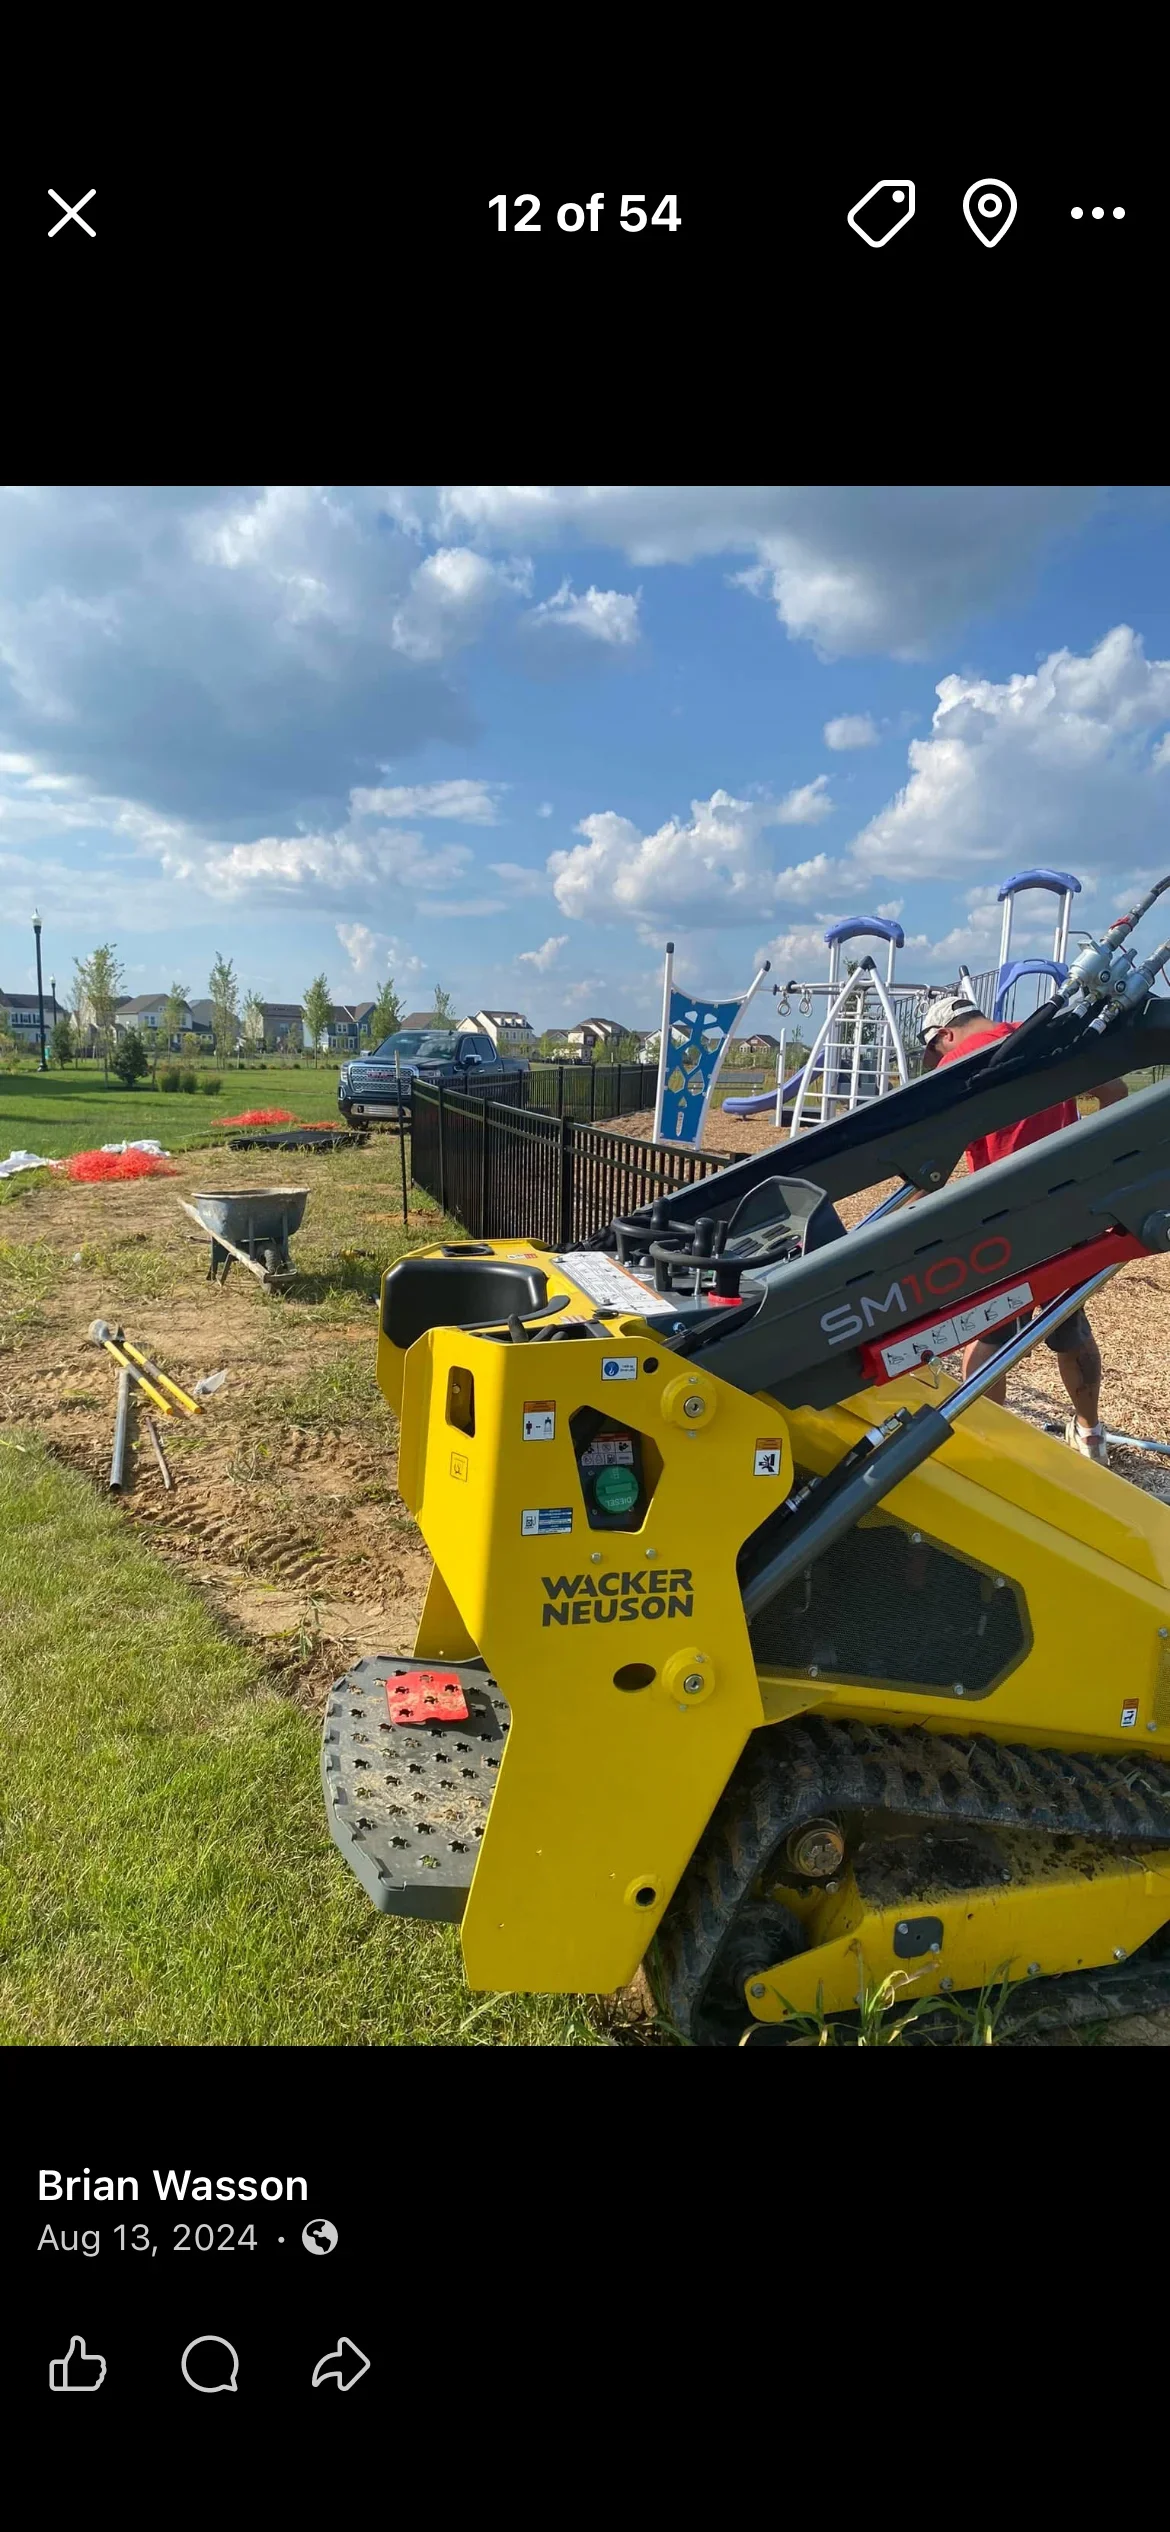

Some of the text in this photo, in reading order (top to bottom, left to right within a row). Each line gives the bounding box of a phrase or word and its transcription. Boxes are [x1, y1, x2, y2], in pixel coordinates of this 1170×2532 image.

[820, 1236, 1012, 1346] SM100
[604, 1497, 632, 1507] DIESEL
[541, 1569, 694, 1600] WACKER
[542, 1594, 694, 1627] NEUSON
